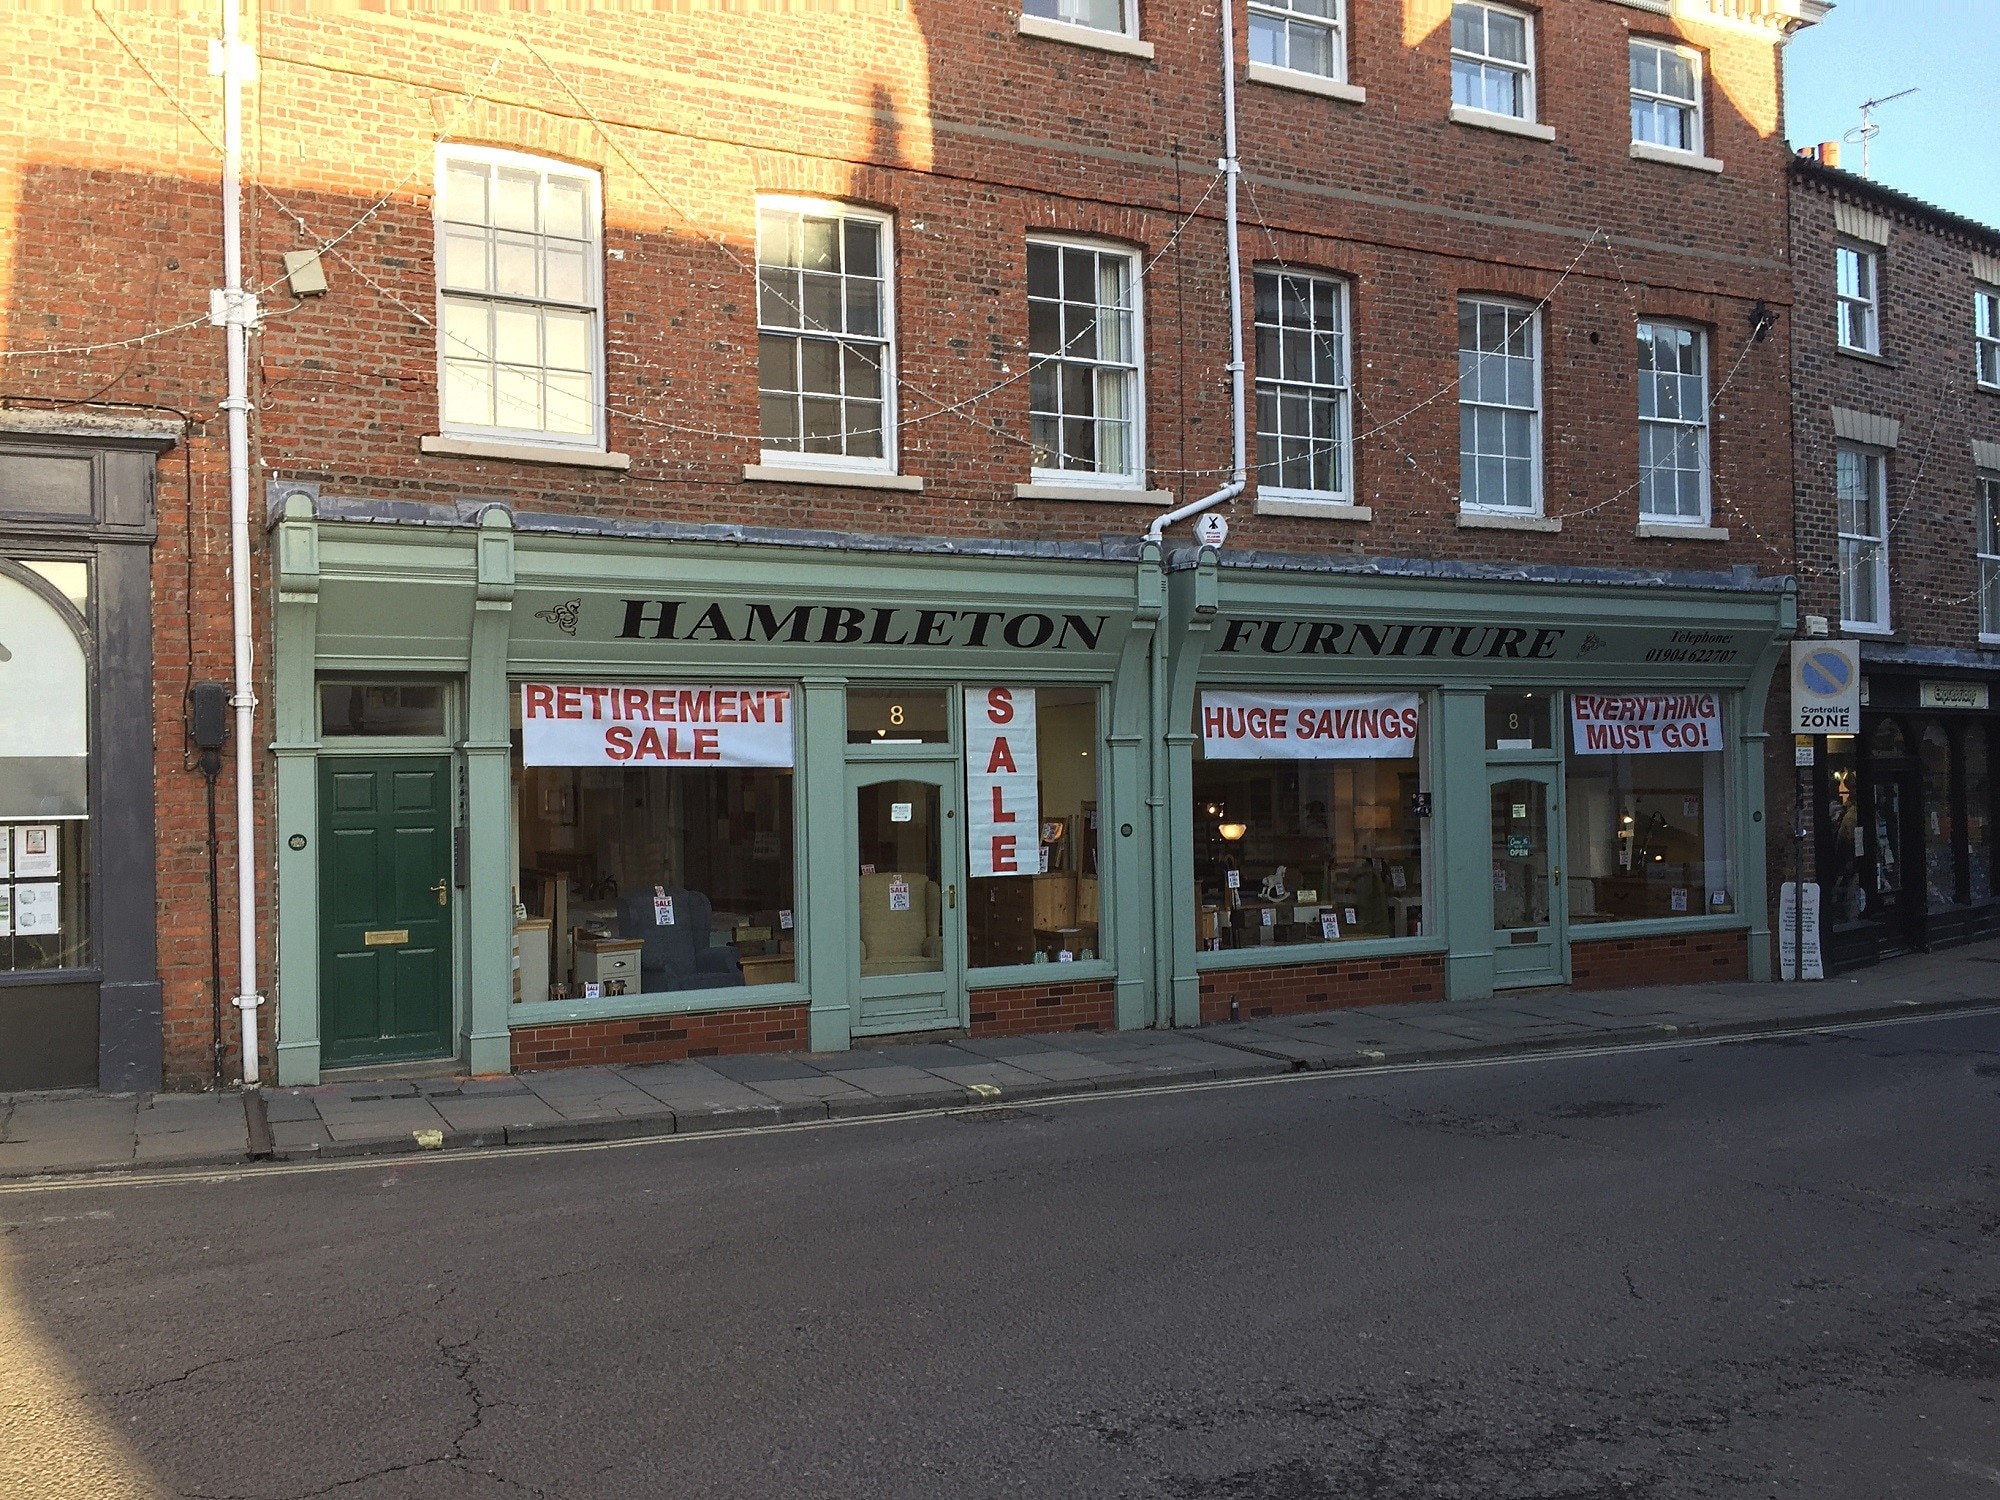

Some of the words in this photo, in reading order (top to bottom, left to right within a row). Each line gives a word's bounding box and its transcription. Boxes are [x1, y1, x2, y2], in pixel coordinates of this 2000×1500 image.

[614, 599, 1111, 650] HAMBLETON
[1671, 630, 1734, 646] Telephone:
[1214, 619, 1566, 659] FURNITURE
[1645, 649, 1687, 662] 01904
[1687, 650, 1738, 663] 622707
[526, 684, 791, 723] RETIREMENT
[890, 705, 905, 725] 8
[1575, 693, 1716, 721] EVERYTHING
[1801, 706, 1850, 714] Controlled
[1204, 706, 1289, 739] HUGE
[1296, 708, 1418, 740] SAVINGS
[1509, 713, 1519, 730] 8
[1800, 714, 1850, 727] ZONE
[605, 726, 721, 760] SALE
[1586, 724, 1655, 749] MUST
[1661, 722, 1709, 748] GO!
[986, 687, 1018, 873] SALE
[1509, 849, 1528, 857] OPEN
